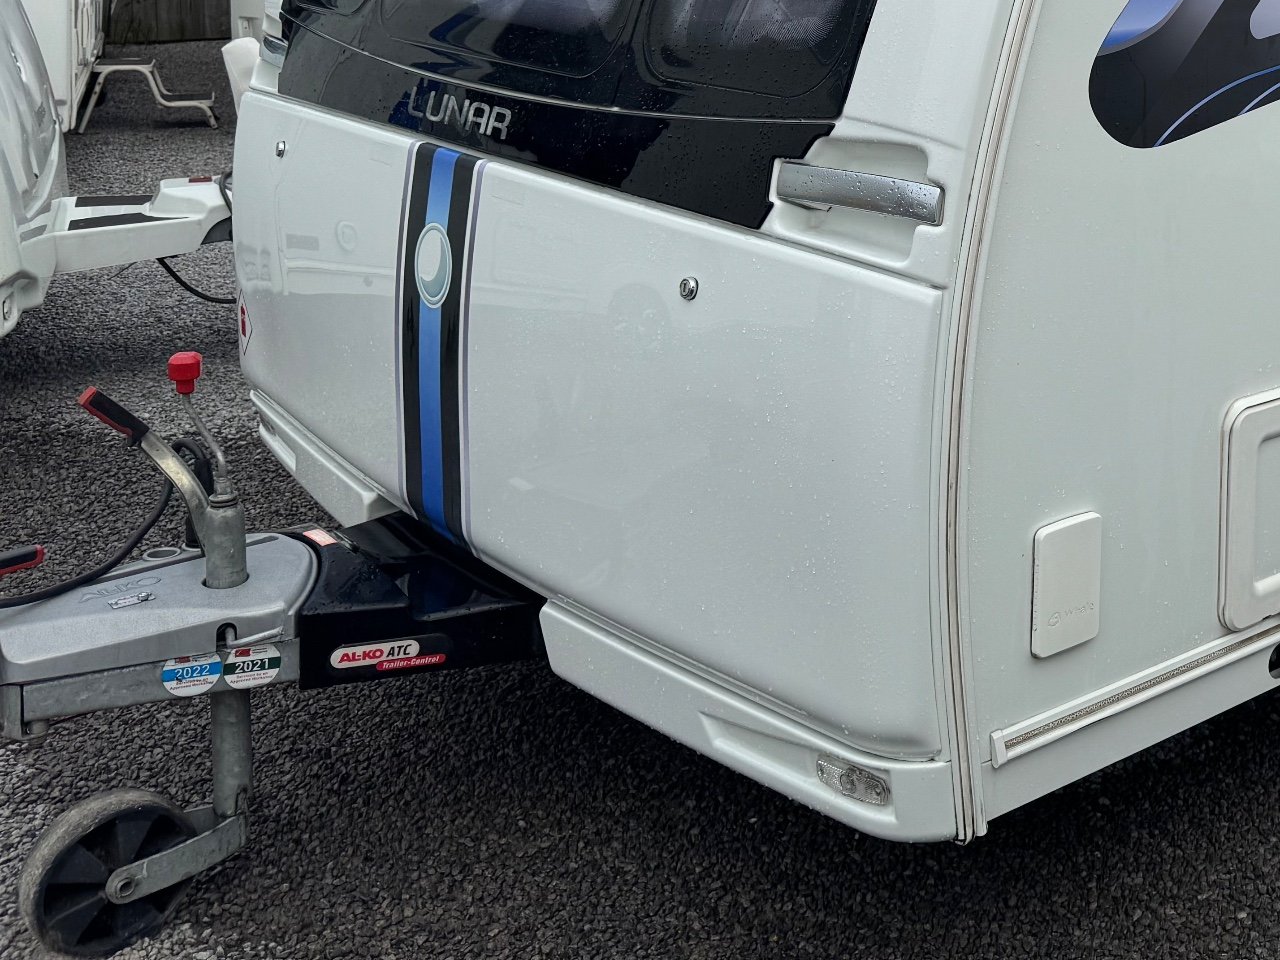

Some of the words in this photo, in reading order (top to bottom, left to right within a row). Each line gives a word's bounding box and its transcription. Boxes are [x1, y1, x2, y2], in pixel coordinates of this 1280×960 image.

[408, 86, 512, 139] LUNAR
[338, 649, 384, 663] AL-KO
[387, 644, 412, 657] ATC
[235, 659, 269, 673] 2021
[383, 656, 440, 669] Trailer-Control
[175, 665, 210, 679] 2022
